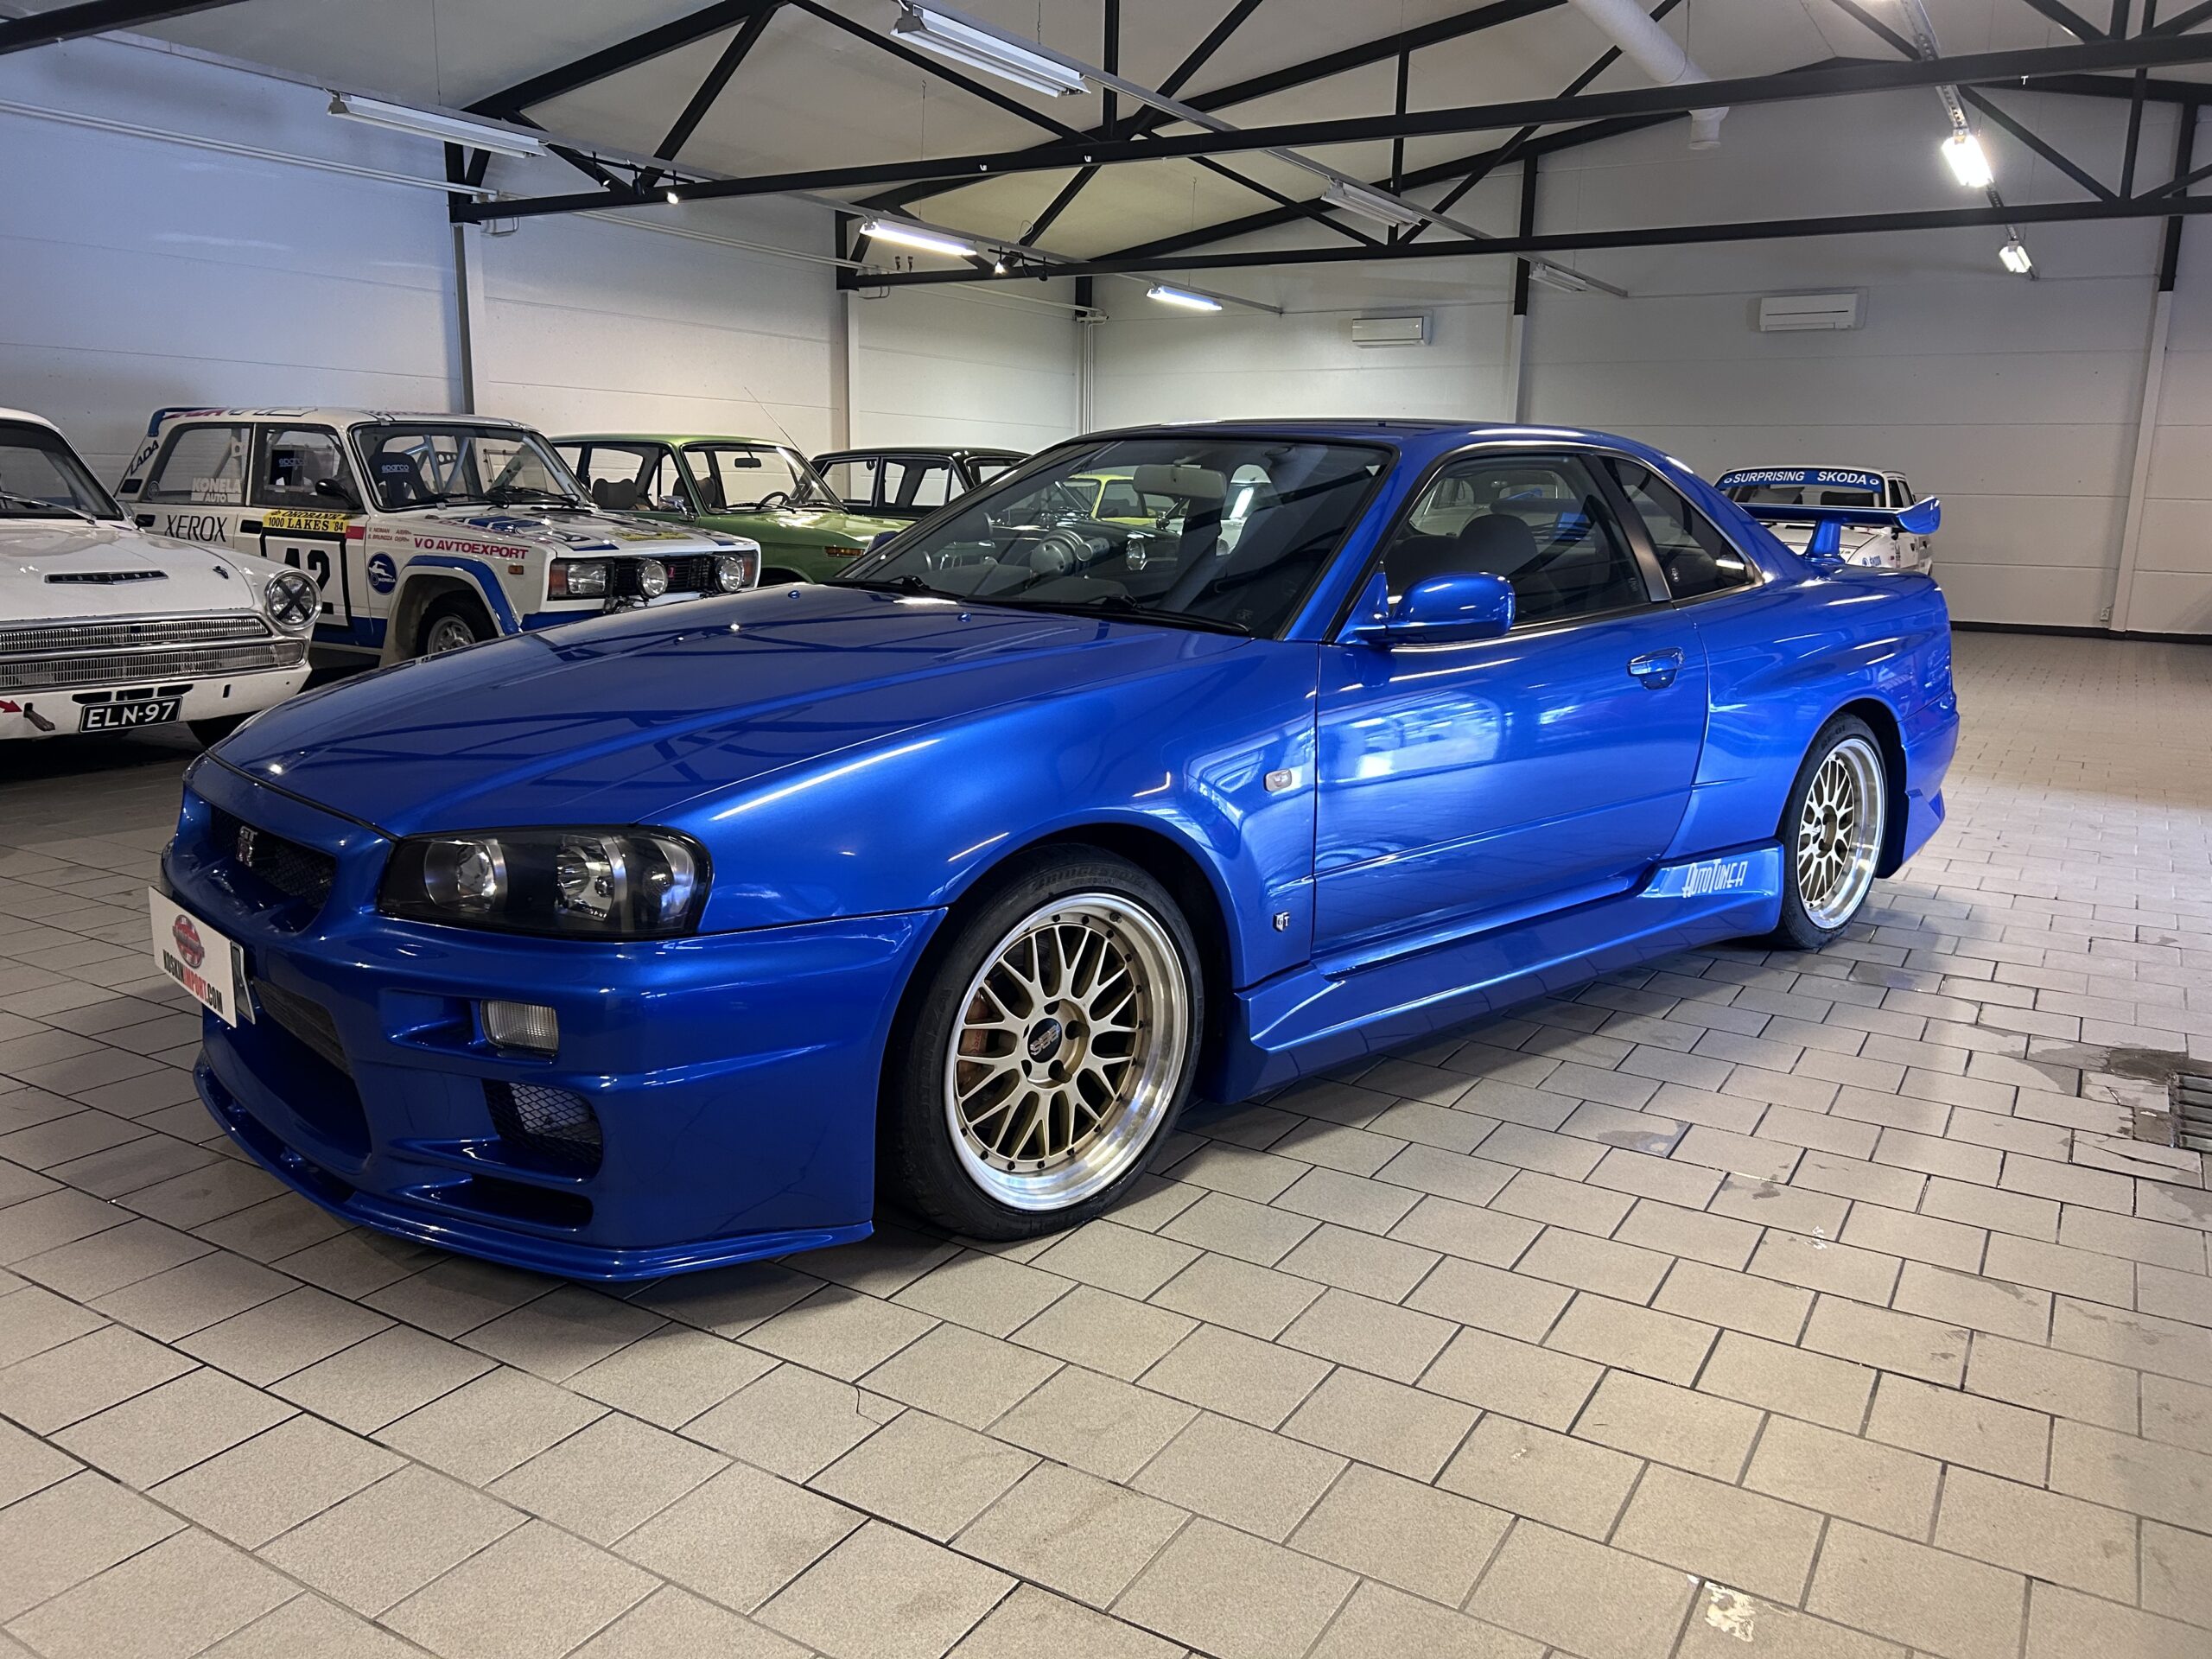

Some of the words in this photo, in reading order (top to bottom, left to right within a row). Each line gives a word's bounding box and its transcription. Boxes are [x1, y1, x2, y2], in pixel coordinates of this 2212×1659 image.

[130, 440, 159, 474] LADA
[193, 477, 242, 493] KONELA
[1732, 471, 1805, 483] SURPRISING
[1817, 471, 1866, 485] SKODA
[205, 493, 227, 503] AUTO
[164, 514, 227, 543] XEROX
[269, 517, 284, 527] 1000
[287, 518, 329, 531] LAKES
[436, 539, 529, 559] AVTOEXPORT
[86, 701, 176, 728] ELN-97
